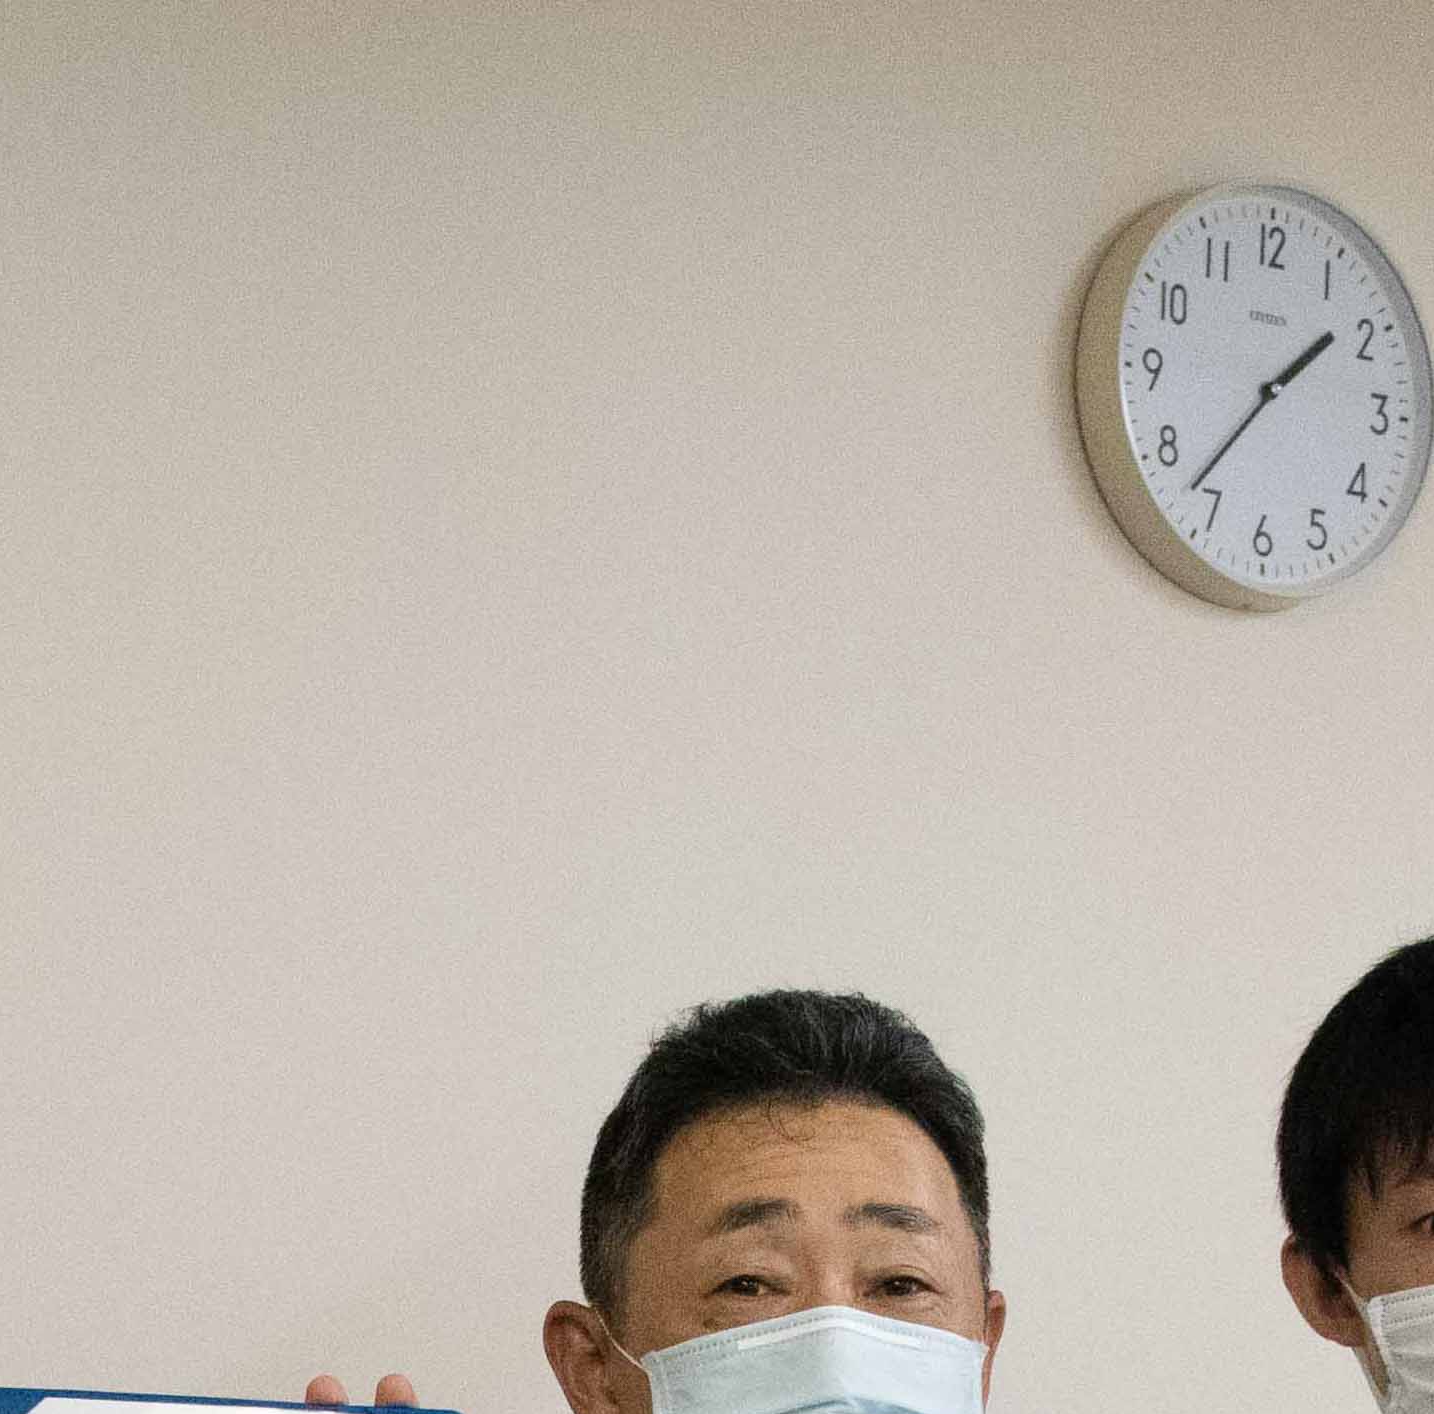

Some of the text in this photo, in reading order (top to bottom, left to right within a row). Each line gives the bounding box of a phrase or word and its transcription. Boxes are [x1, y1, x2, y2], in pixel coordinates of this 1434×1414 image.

[1205, 237, 1231, 283] 11
[1259, 223, 1287, 270] 12
[1323, 259, 1332, 300] 1
[1160, 281, 1188, 326] 10
[1356, 318, 1375, 362] 2
[1142, 347, 1164, 392] 9
[1370, 392, 1389, 436] 3
[1158, 424, 1179, 467] 8
[1346, 461, 1368, 503] 4
[1202, 487, 1223, 533] 7
[1306, 508, 1327, 551] 5
[1252, 513, 1273, 557] 6
